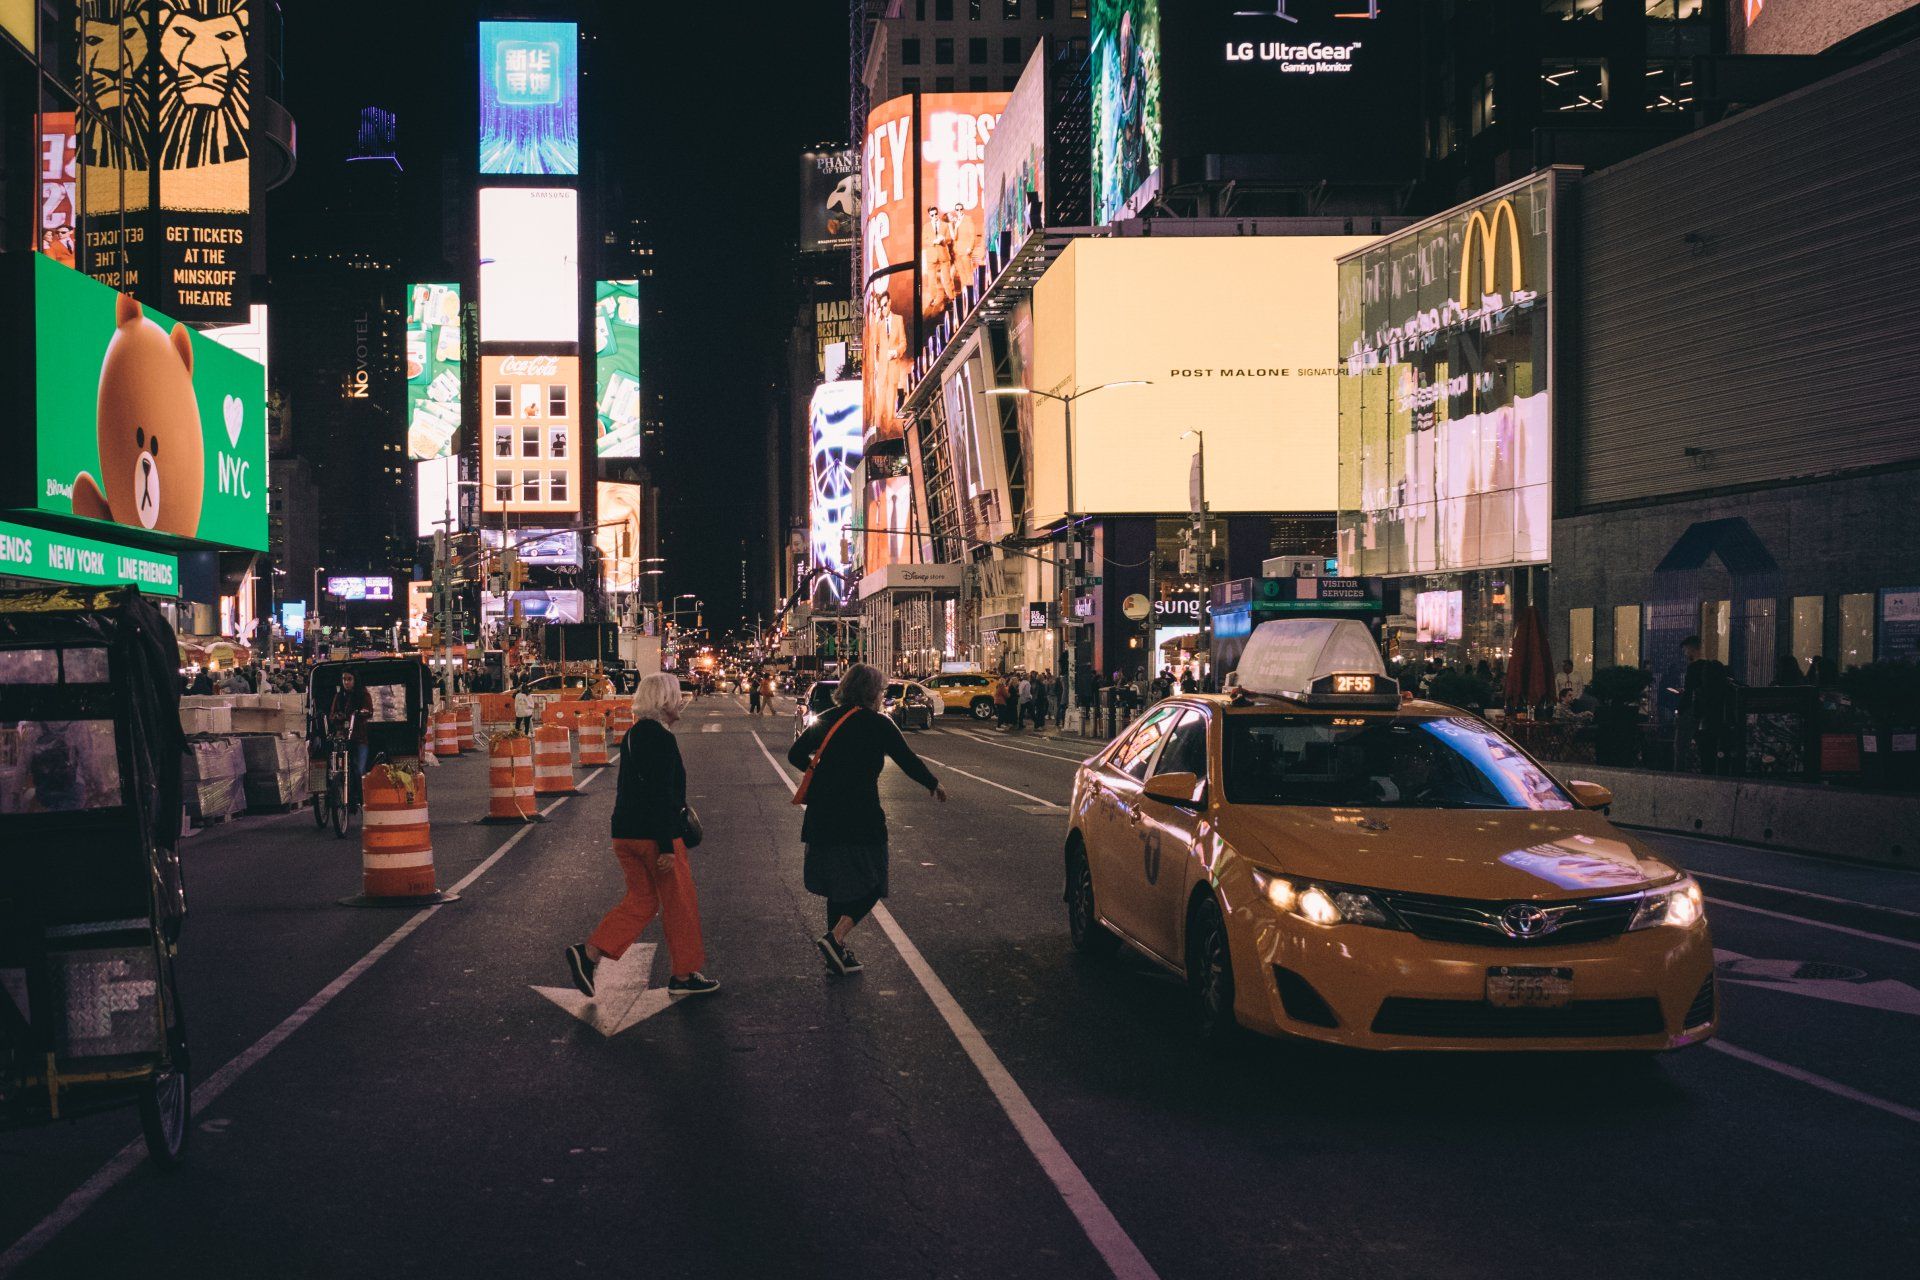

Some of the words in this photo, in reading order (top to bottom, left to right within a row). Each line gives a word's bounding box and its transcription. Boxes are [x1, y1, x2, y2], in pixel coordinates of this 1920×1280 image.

[1226, 42, 1254, 61] LG
[1280, 62, 1315, 74] Gaming
[1316, 62, 1352, 72] Monitor
[166, 227, 188, 242] GET
[192, 228, 243, 244] TICKETS
[184, 249, 199, 263] AT
[202, 249, 225, 264] THE
[174, 269, 236, 285] MINSKOFF
[178, 290, 232, 306] THEATRE
[353, 311, 369, 398] NOVOTEL
[1170, 368, 1213, 378] POST
[1220, 368, 1290, 378] MALONE
[217, 450, 251, 499] NYC
[48, 543, 74, 570] NEW
[77, 549, 105, 575] YORK
[117, 556, 137, 579] LINE
[138, 560, 173, 585] FRIENDS
[1323, 580, 1359, 588] VISITOR
[1322, 590, 1365, 598] SERVICES
[1337, 676, 1372, 691] 2F55
